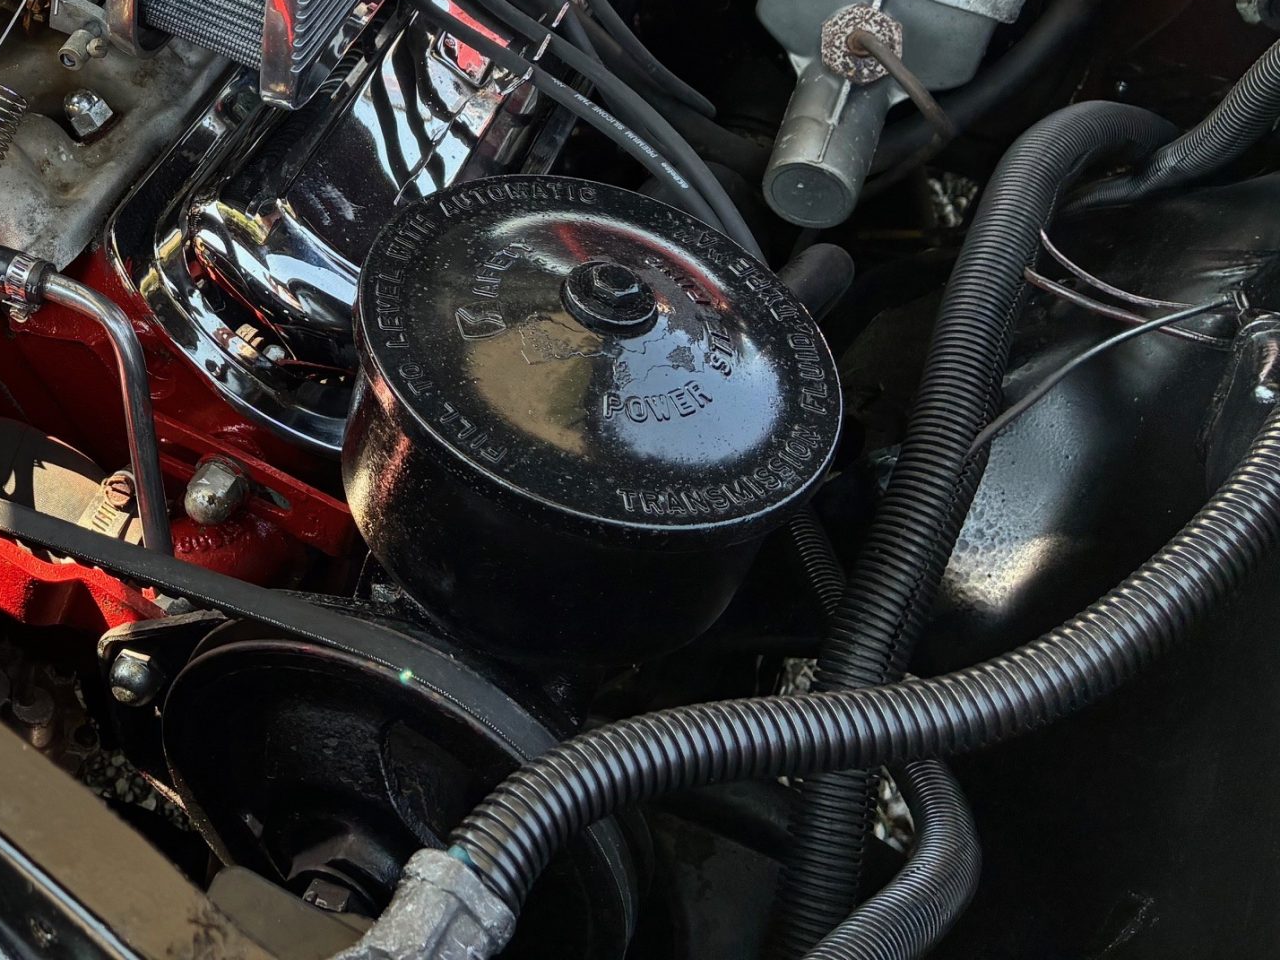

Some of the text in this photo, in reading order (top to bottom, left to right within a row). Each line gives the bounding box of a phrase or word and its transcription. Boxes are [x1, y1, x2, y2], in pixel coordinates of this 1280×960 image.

[589, 100, 625, 133] SILICONE
[622, 126, 658, 159] PREMIUM
[439, 179, 599, 218] AUTOMATIC
[396, 213, 437, 266] WITH
[375, 271, 407, 349] LEVEL
[728, 256, 801, 323] TYPE
[398, 361, 434, 396] TO
[602, 379, 714, 423] POWER
[439, 401, 509, 465] FILL
[616, 422, 823, 516] TRANSMISSION
